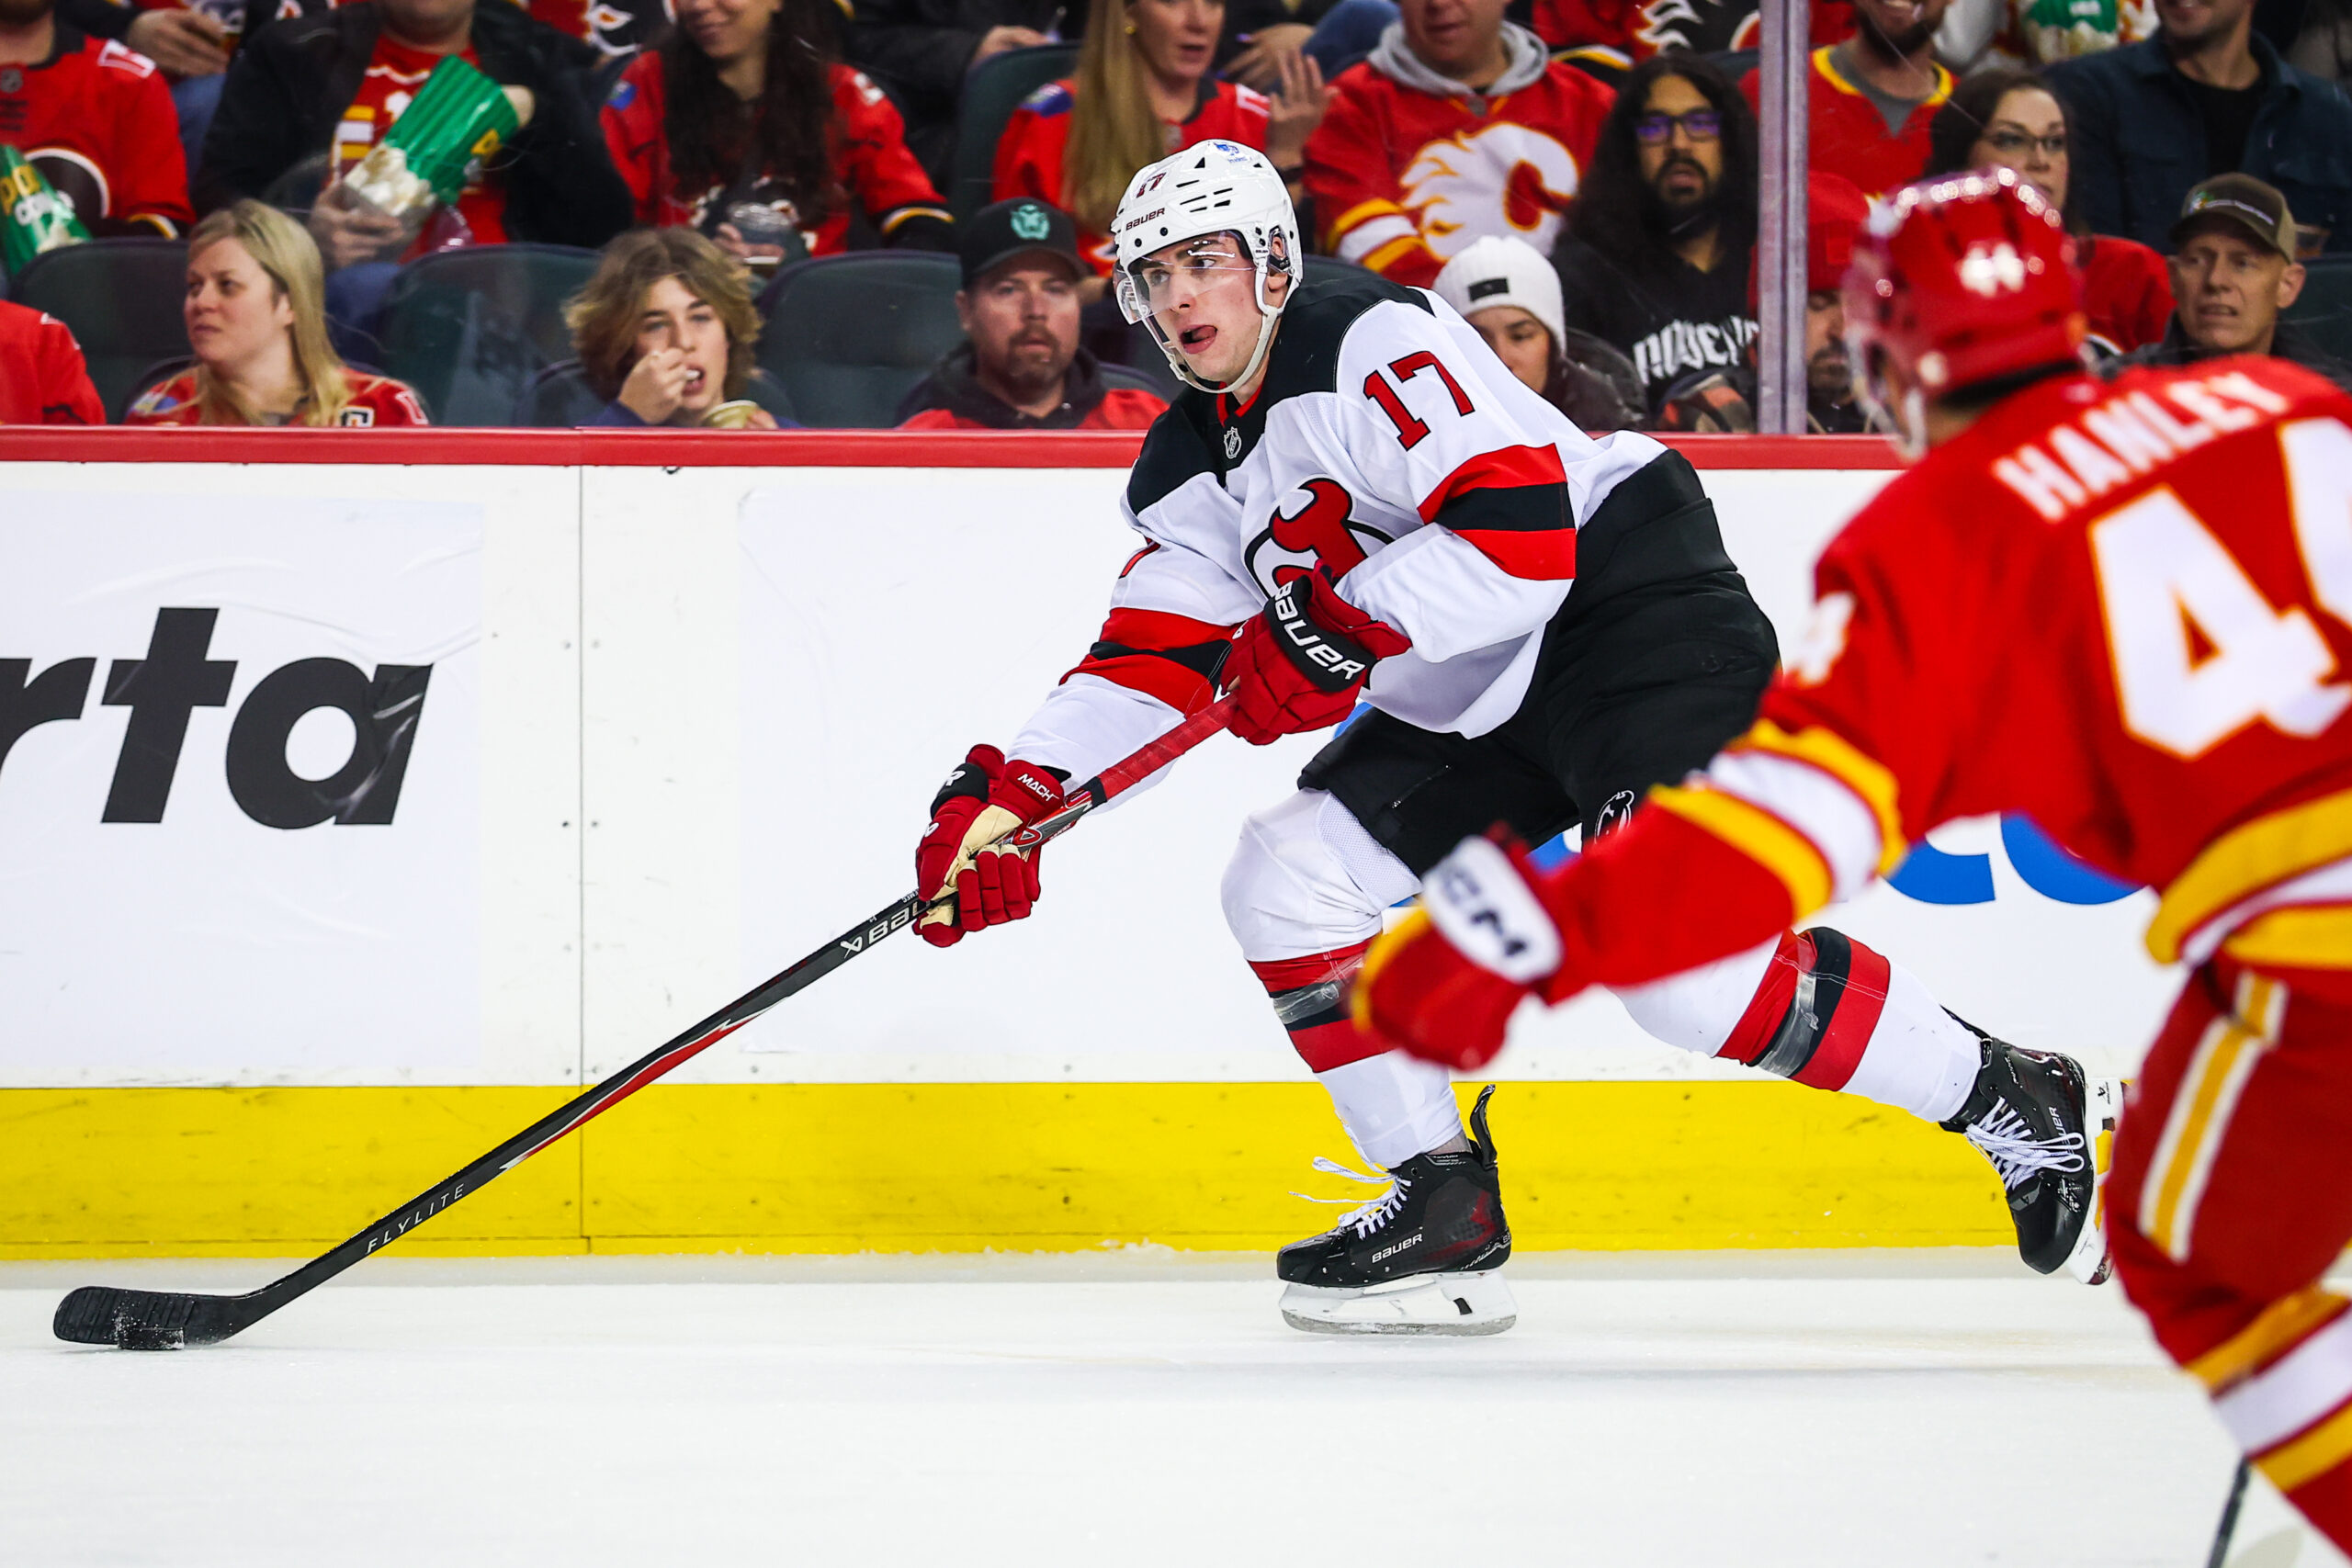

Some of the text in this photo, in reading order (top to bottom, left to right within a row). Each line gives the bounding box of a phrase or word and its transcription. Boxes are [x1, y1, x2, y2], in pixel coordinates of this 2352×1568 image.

[1125, 208, 1166, 231] BAUER
[1136, 172, 1167, 198] 17
[1363, 350, 1476, 451] 17
[1991, 371, 2290, 524] HANLEY
[1274, 581, 1365, 681] BAUER
[0, 607, 435, 829] rta
[1017, 773, 1059, 802] MACH
[367, 1183, 465, 1255] FLYLITE
[1371, 1233, 1424, 1264] BAUER
